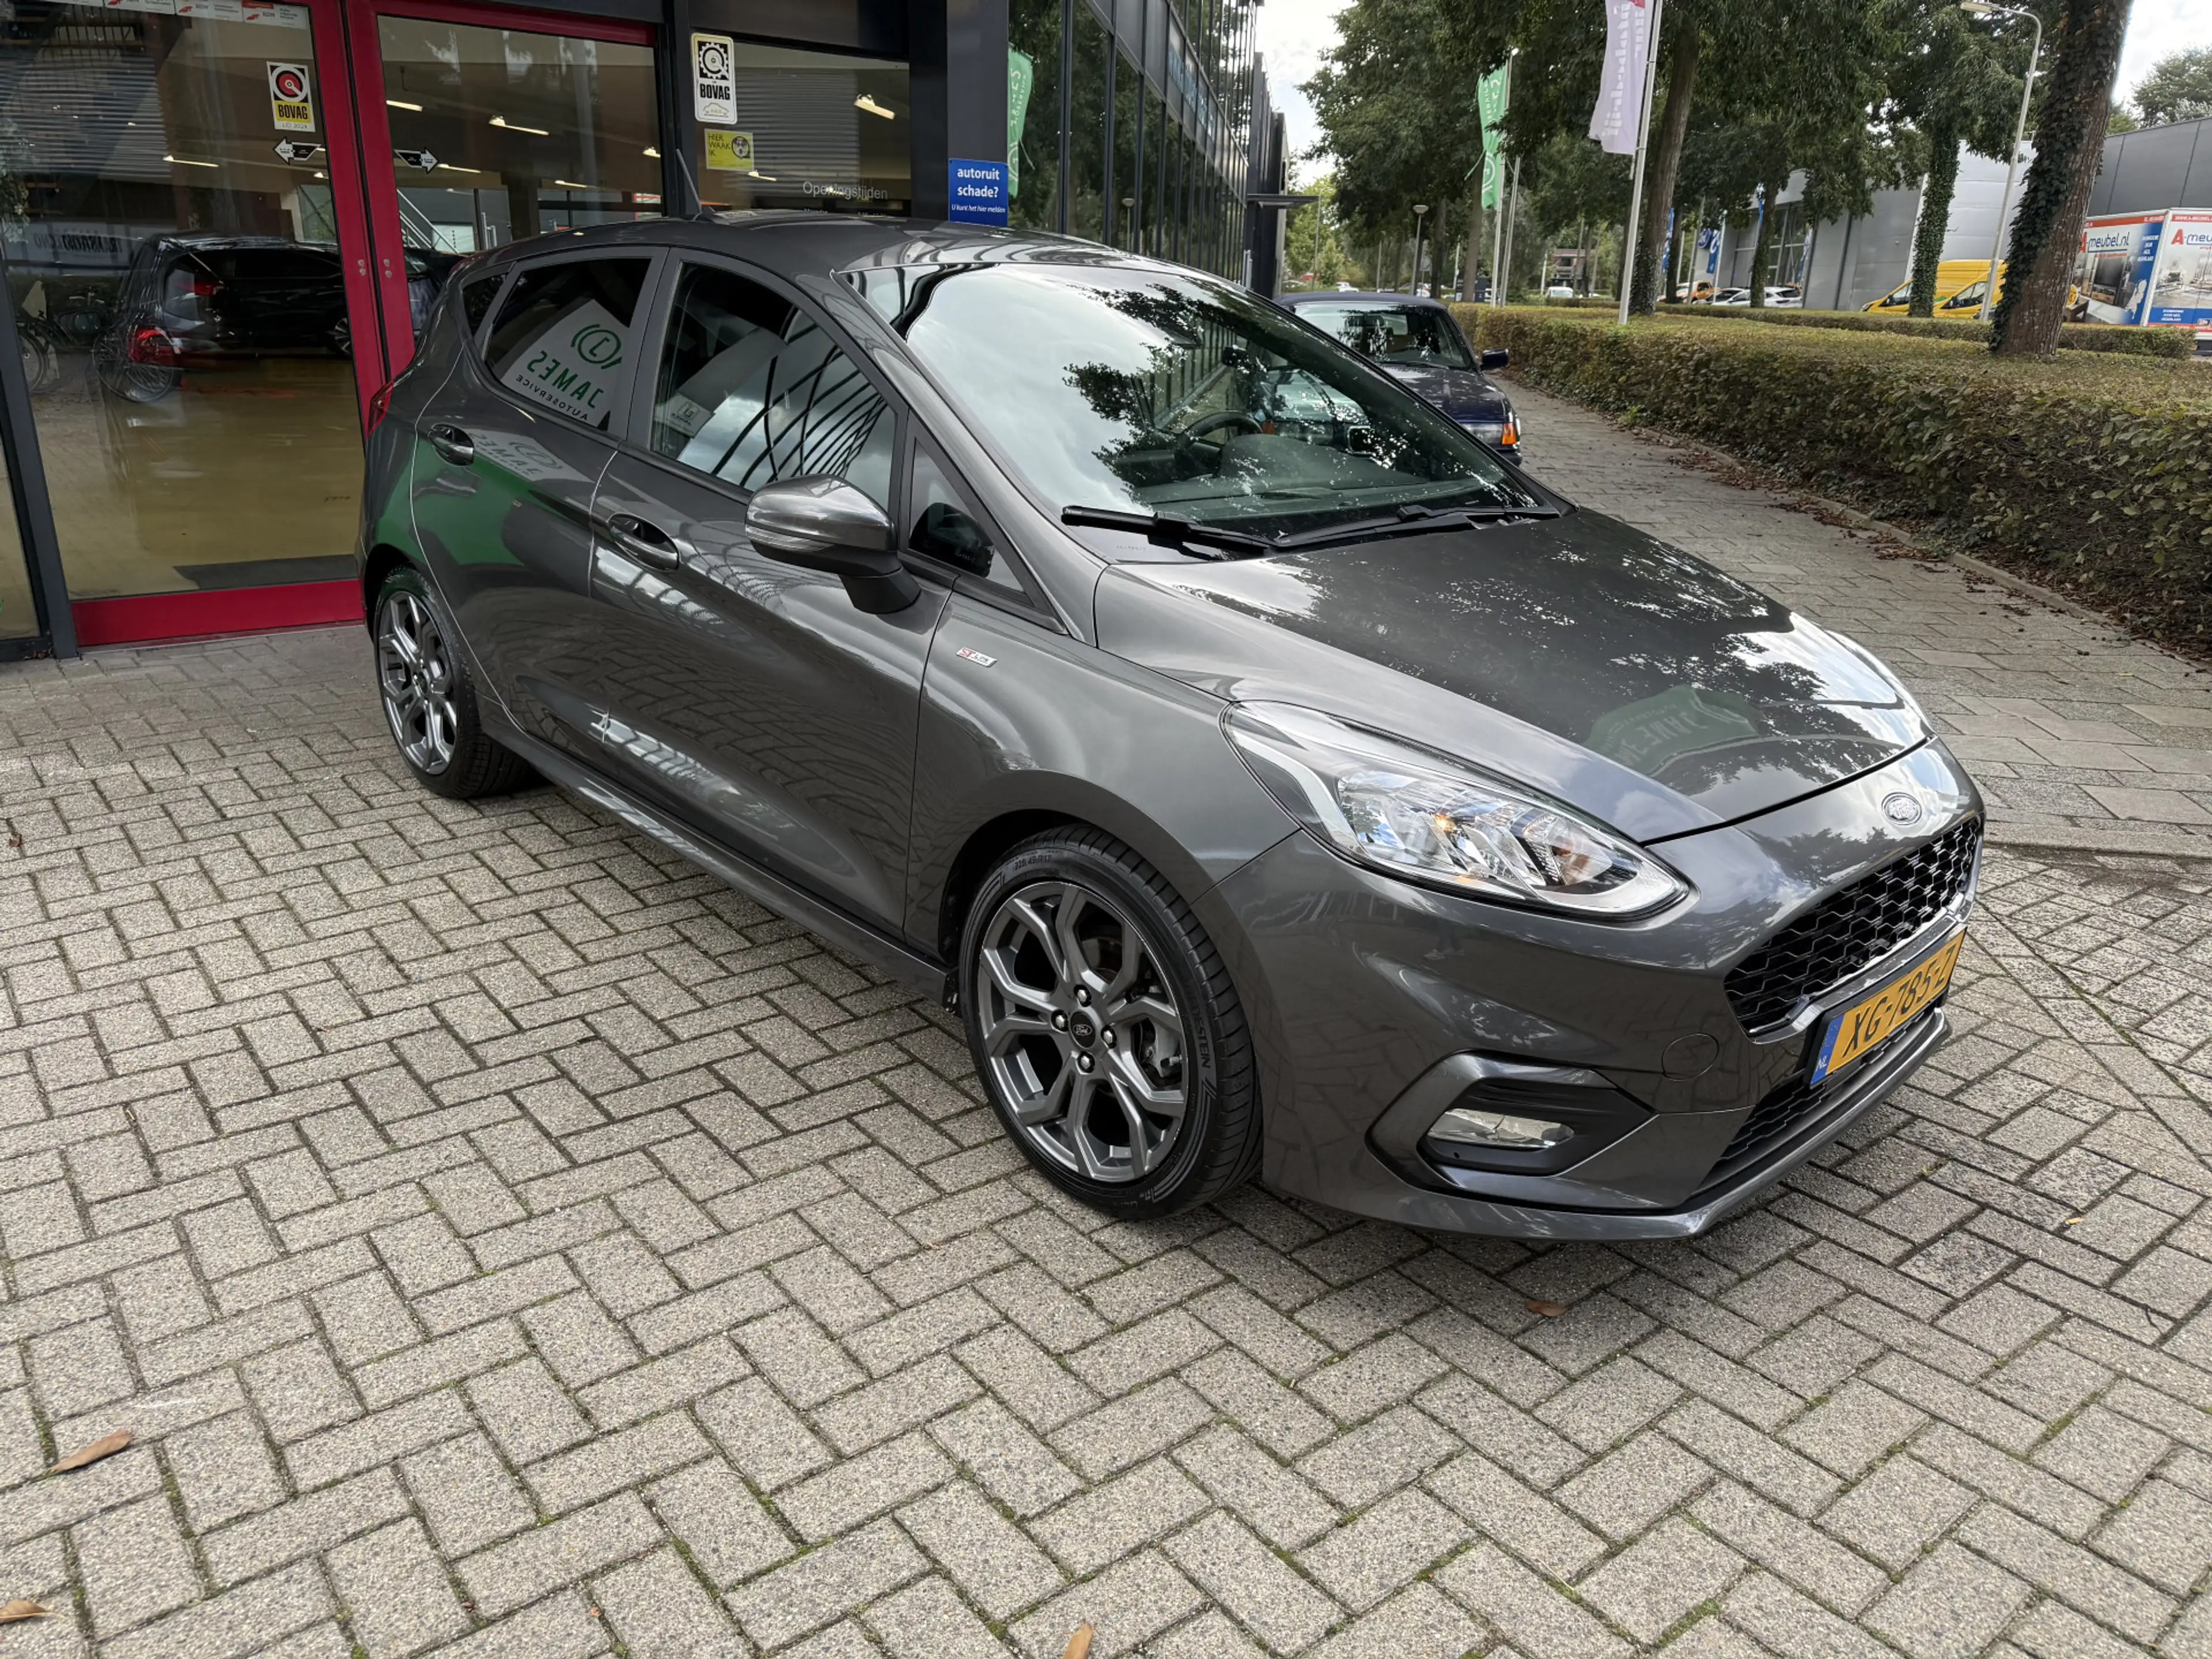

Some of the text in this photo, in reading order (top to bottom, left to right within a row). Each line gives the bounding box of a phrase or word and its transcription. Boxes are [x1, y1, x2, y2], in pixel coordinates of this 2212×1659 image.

[700, 84, 730, 100] BOVAG
[278, 104, 308, 120] BOVAG
[709, 133, 724, 141] HIER
[709, 142, 730, 150] WAAK
[957, 168, 999, 180] autoruit
[803, 181, 888, 200] Openingstijden
[957, 184, 998, 198] schade?
[2077, 231, 2130, 253] A-meubel.nl
